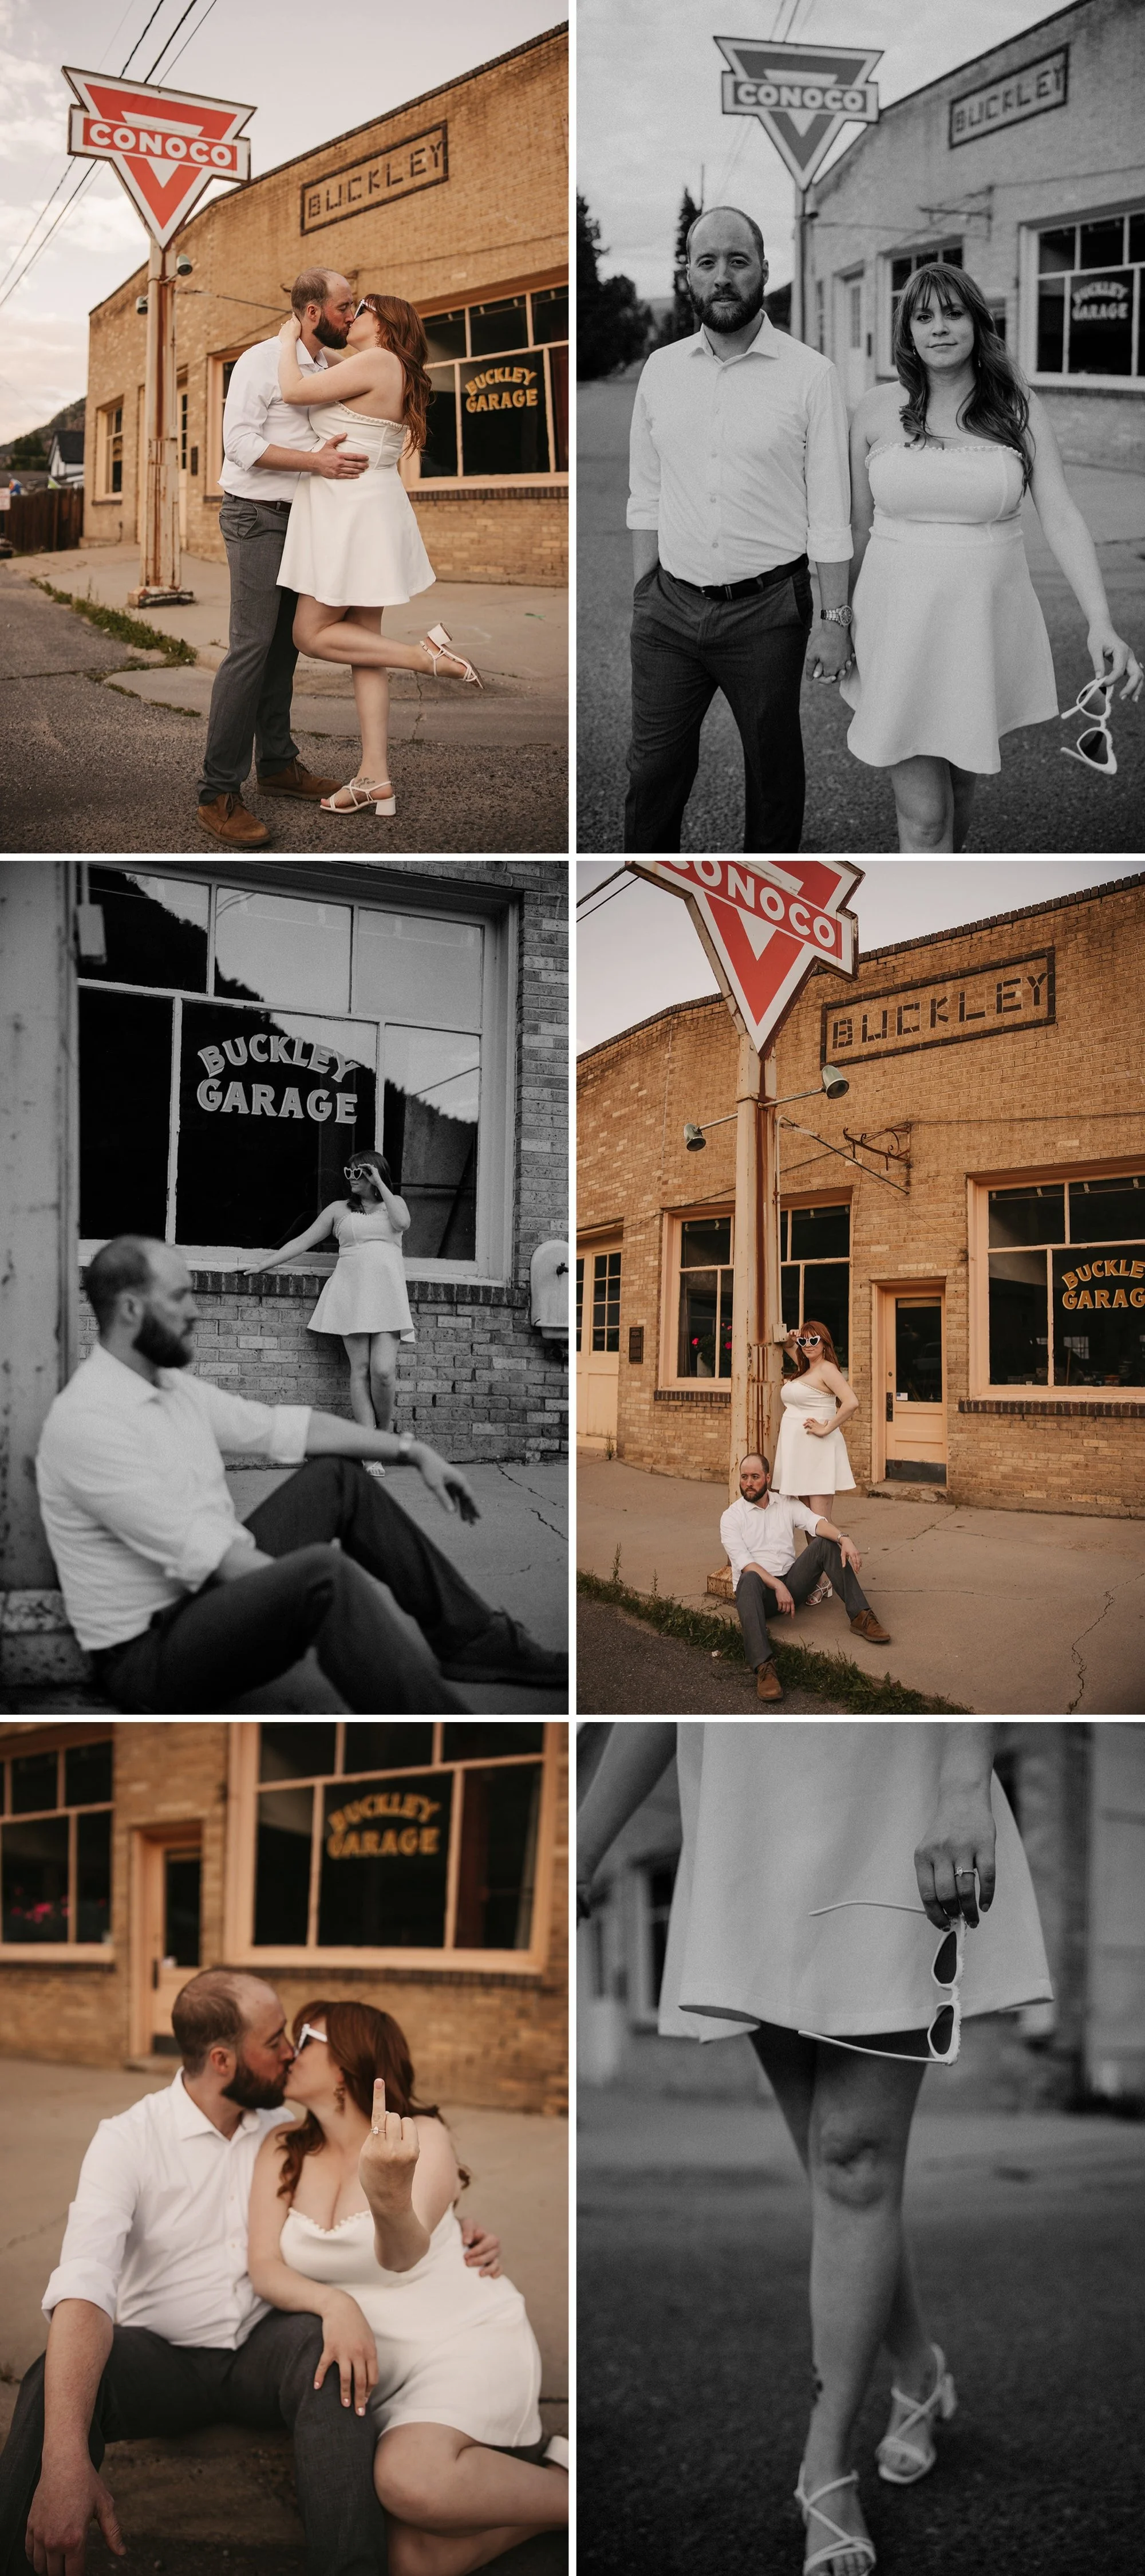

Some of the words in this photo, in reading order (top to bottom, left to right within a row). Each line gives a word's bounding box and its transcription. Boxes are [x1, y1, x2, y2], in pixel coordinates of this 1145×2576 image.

[737, 83, 864, 112] CONOCO
[955, 64, 1067, 132] BUCKLEY
[89, 123, 232, 167] CONOCO
[309, 140, 446, 219] BUCKLEY
[465, 367, 537, 396] BUCKLEY
[465, 388, 538, 413] GARAGE
[832, 972, 1048, 1049] BUCKLEY
[197, 1034, 361, 1082] BUCKLEY
[196, 1078, 358, 1124] GARAGE
[327, 1792, 441, 1834] BUCKLEY
[327, 1826, 440, 1860] GARAGE
